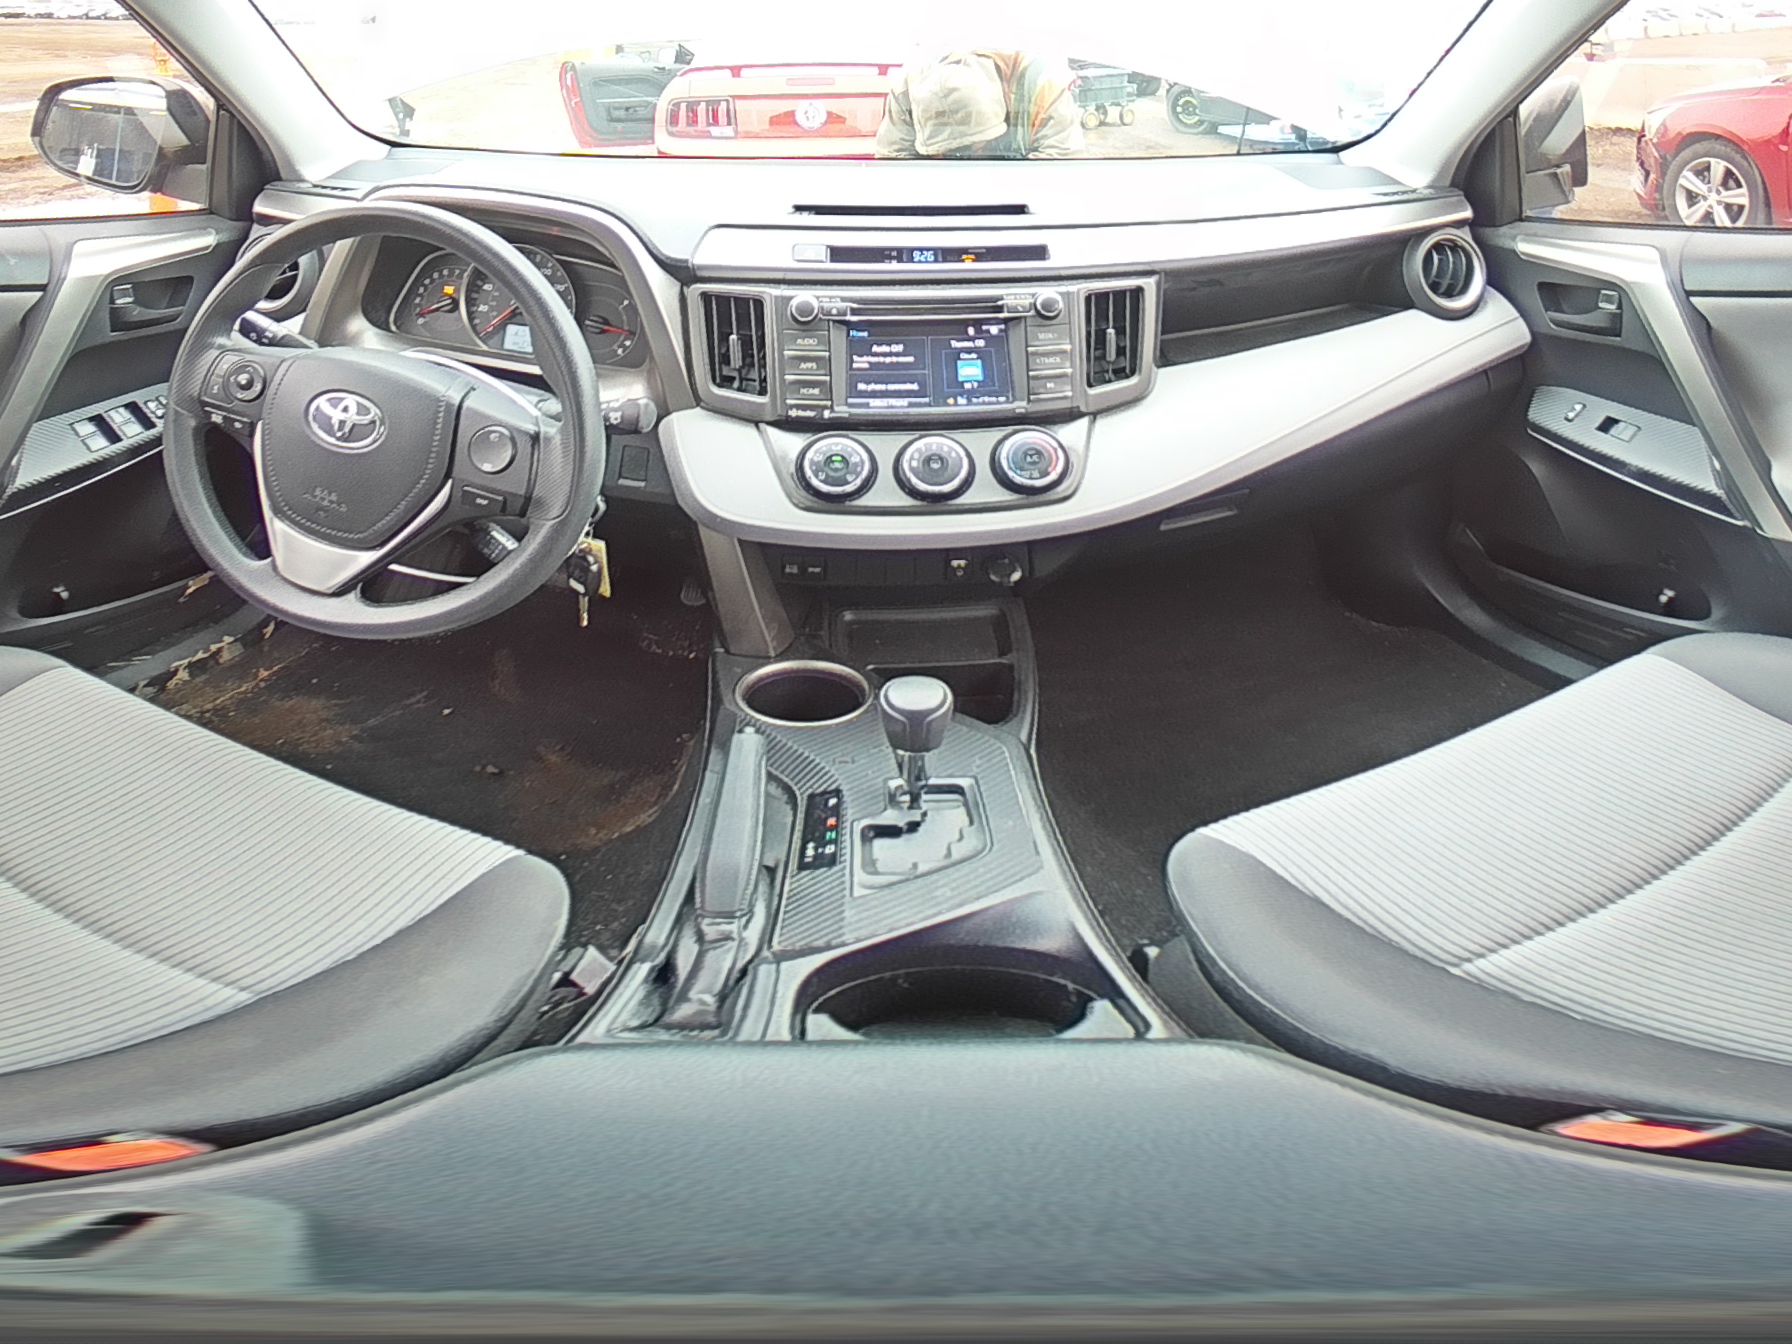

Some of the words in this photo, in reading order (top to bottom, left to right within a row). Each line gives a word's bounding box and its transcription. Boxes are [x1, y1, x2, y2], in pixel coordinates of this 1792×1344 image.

[1041, 356, 1061, 364] TRACK
[799, 361, 818, 370] APPS
[799, 387, 821, 395] HOME
